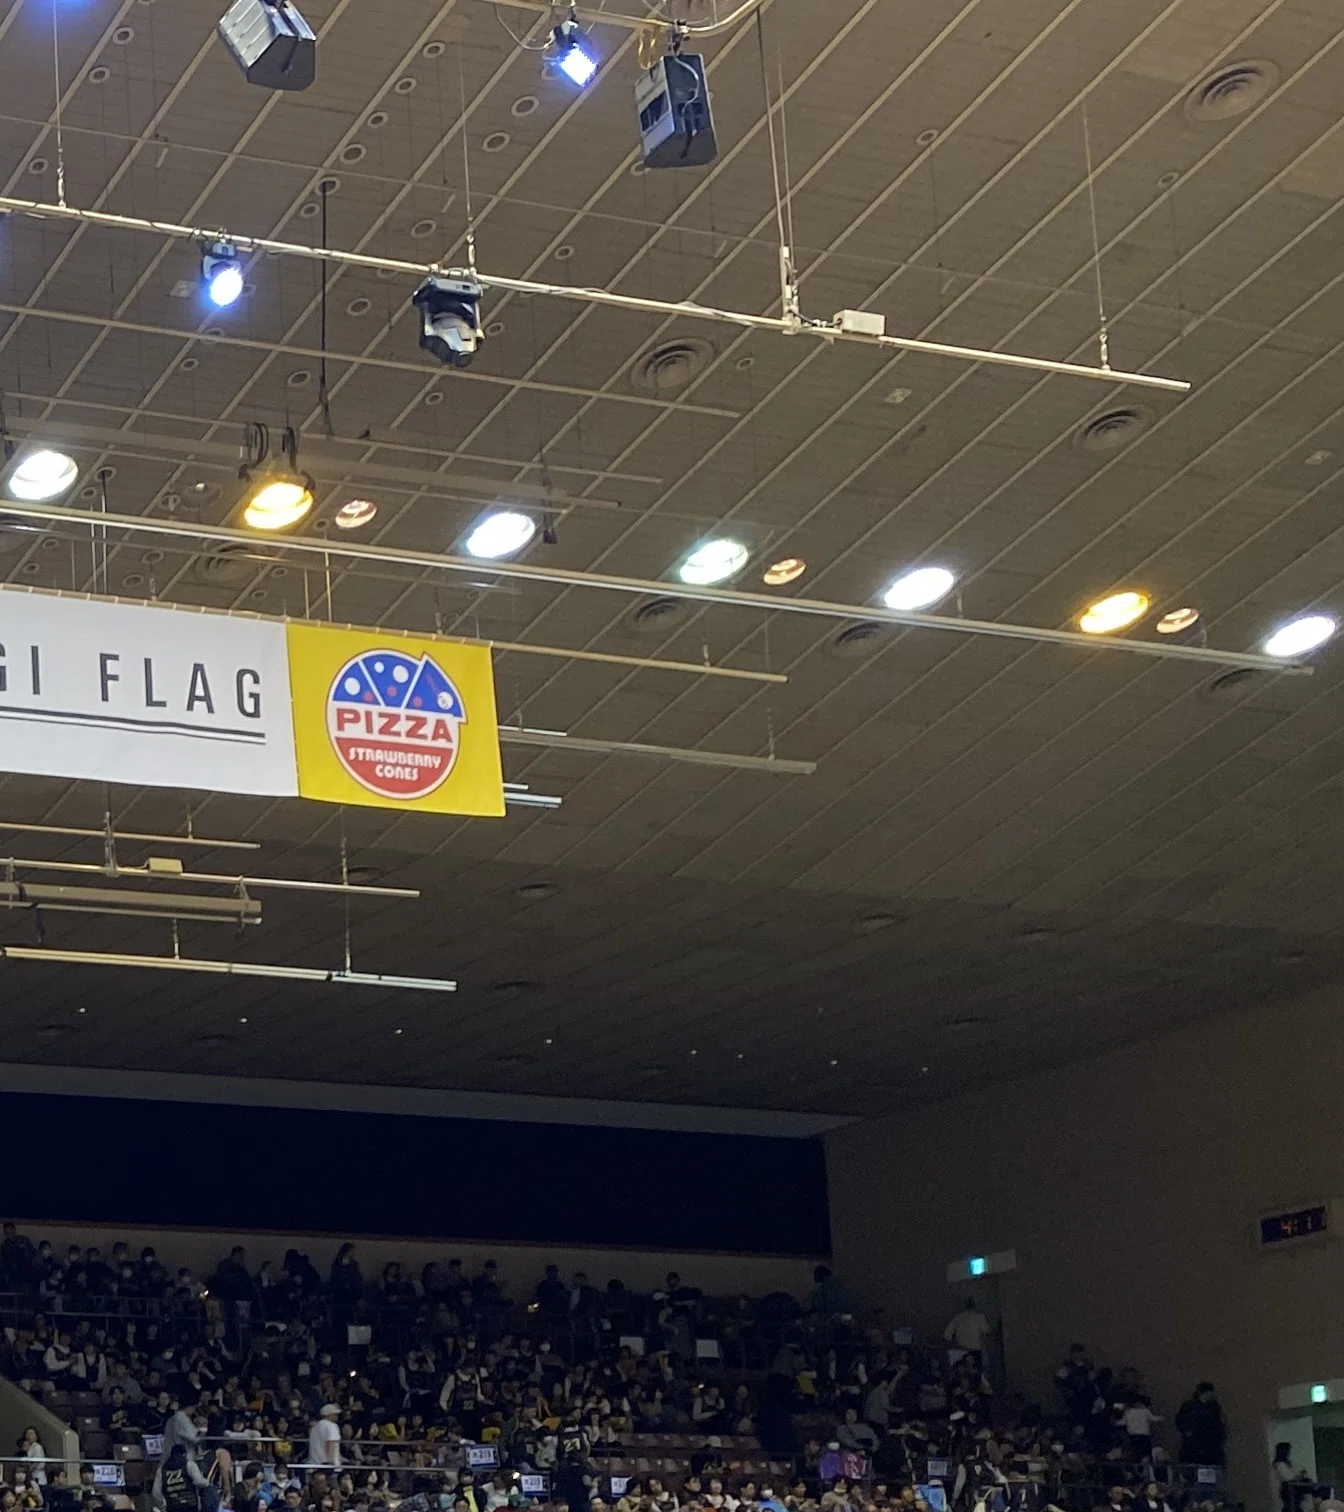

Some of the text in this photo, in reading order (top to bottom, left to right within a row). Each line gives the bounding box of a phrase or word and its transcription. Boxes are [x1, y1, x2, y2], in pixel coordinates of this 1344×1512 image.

[99, 652, 262, 719] FLAG
[336, 707, 454, 744] PIZZA
[348, 747, 441, 769] STRAWBERRY
[374, 764, 419, 782] CONES
